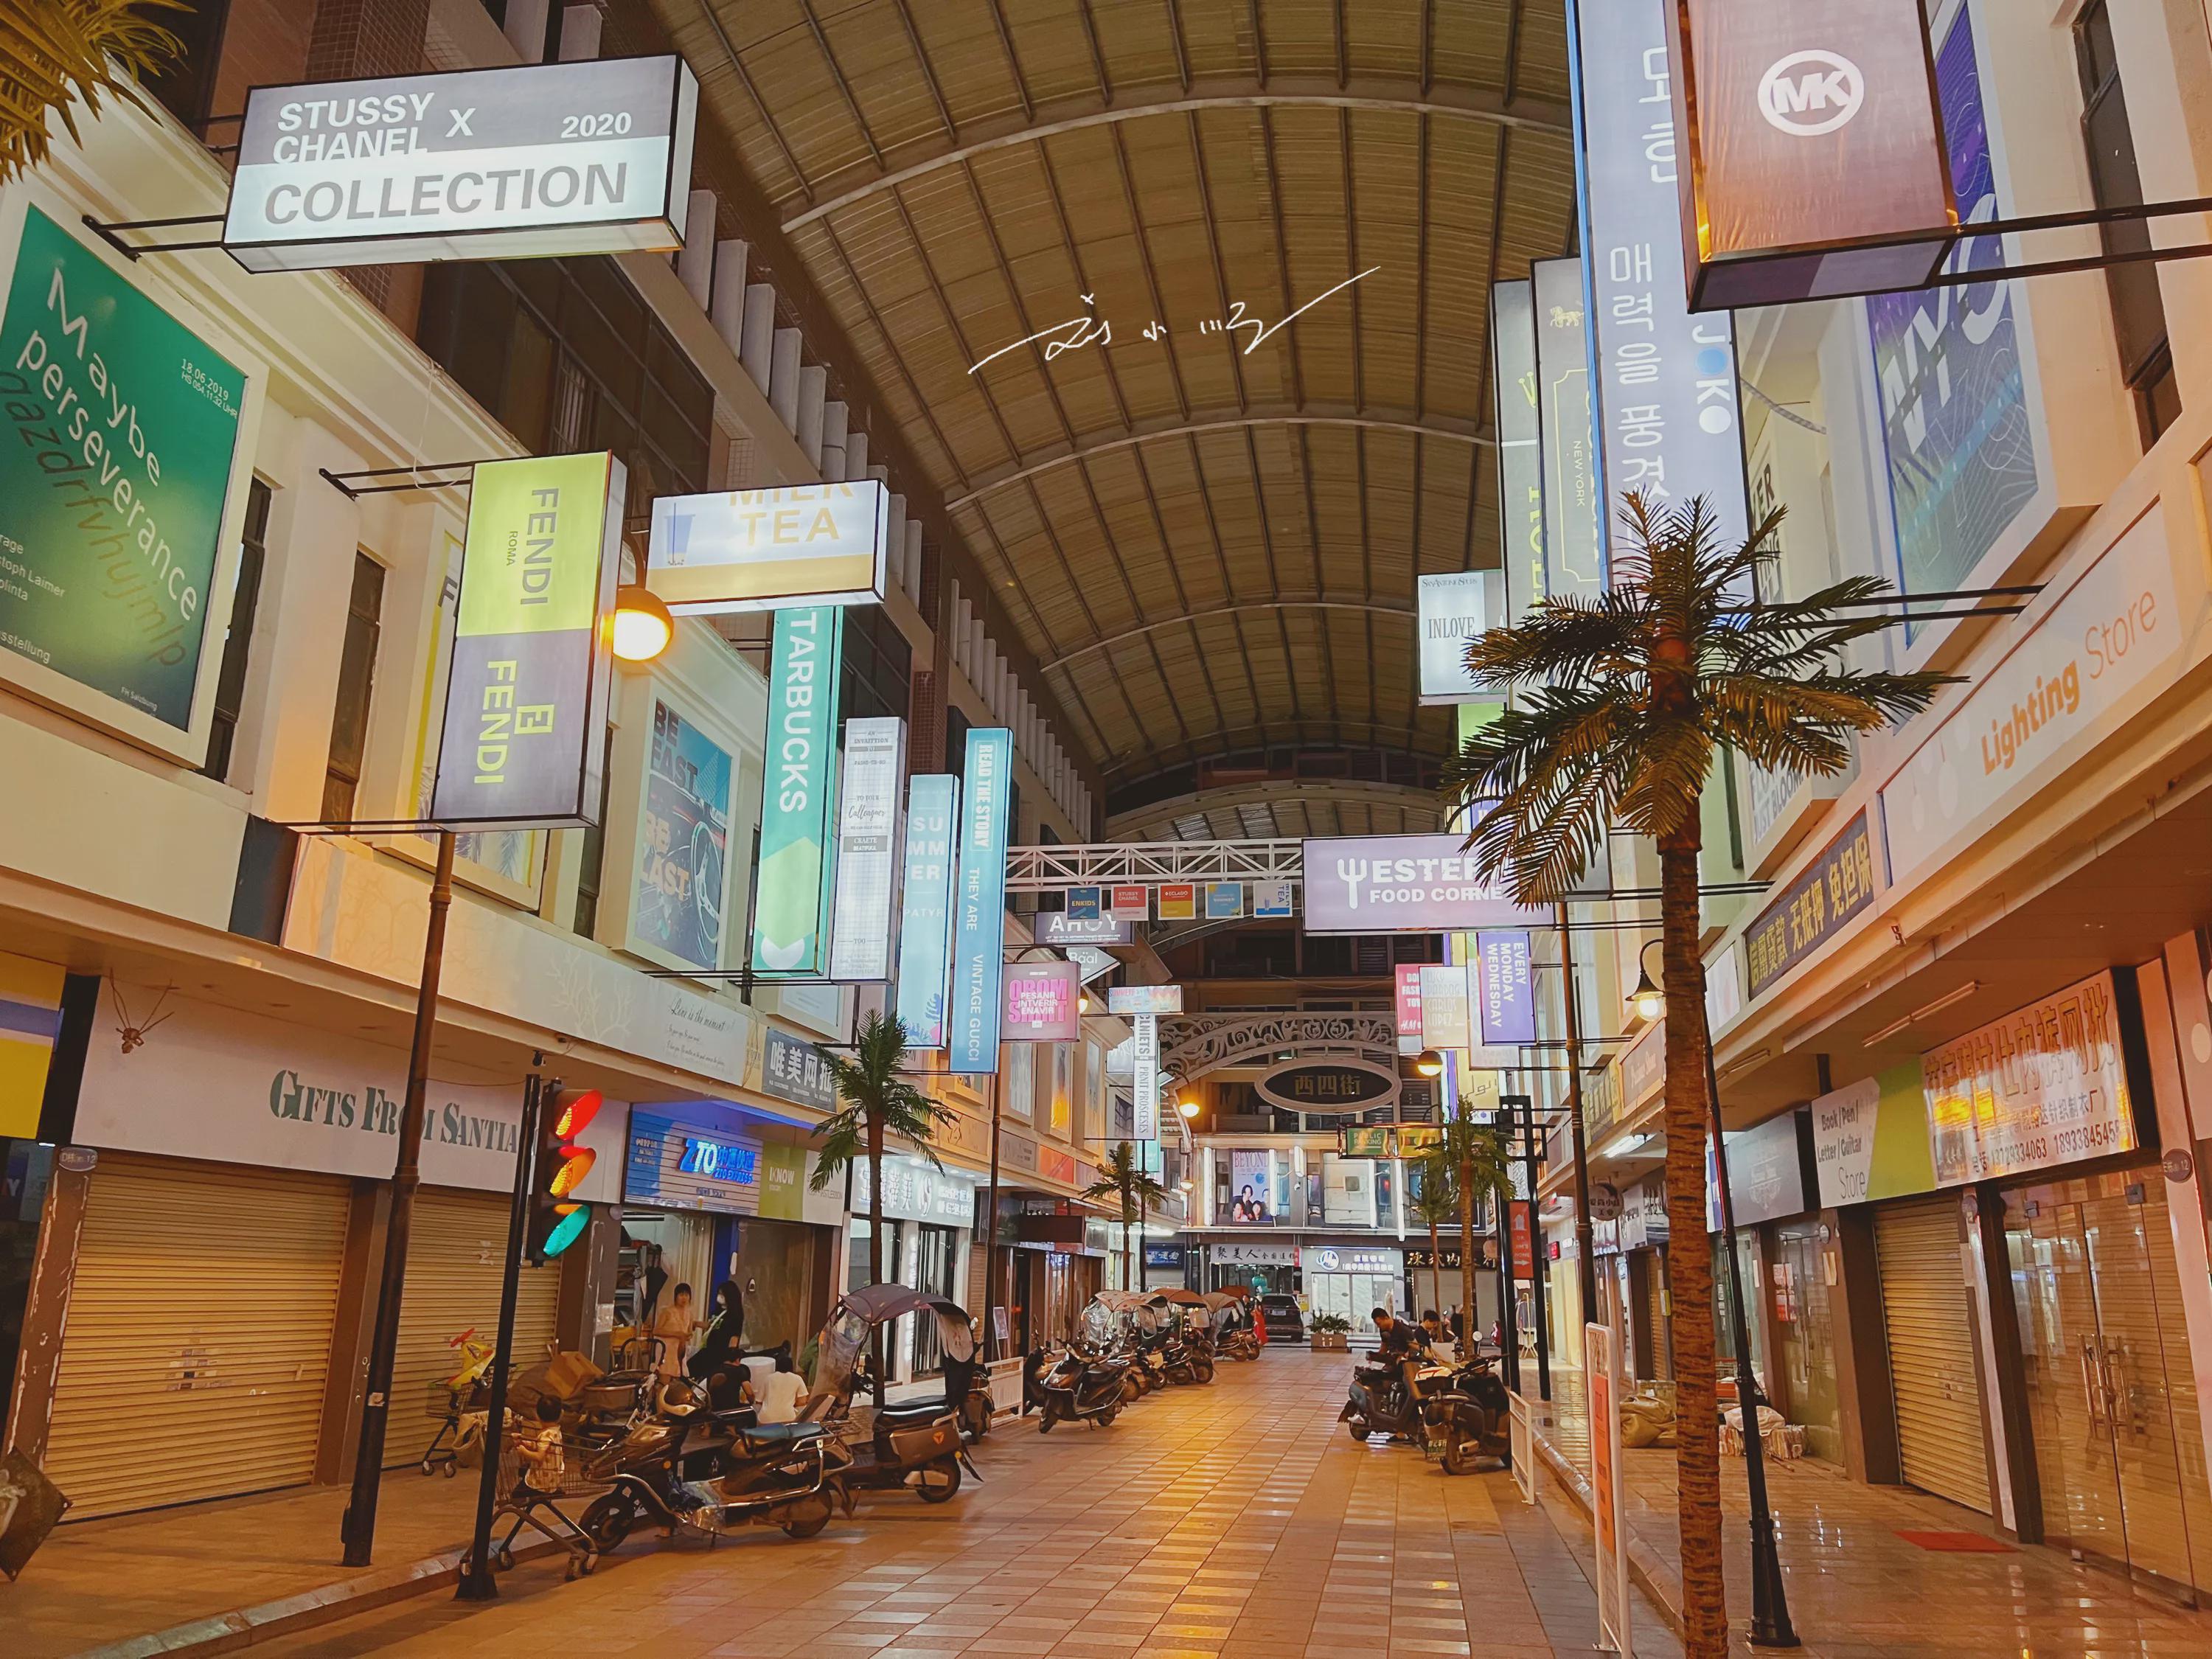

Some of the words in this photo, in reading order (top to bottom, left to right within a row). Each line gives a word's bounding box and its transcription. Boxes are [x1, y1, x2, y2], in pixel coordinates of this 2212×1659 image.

[276, 91, 434, 132] STUSSY
[1773, 70, 1851, 114] MK
[272, 126, 428, 165] CHANEL
[445, 107, 476, 138] X
[561, 112, 633, 139] 2020
[264, 161, 627, 226] COLLECTION
[46, 267, 161, 487] Maybe
[181, 358, 229, 401] 18.06.2019
[15, 329, 198, 621] perseverance
[1573, 440, 1583, 470] NEW
[1576, 471, 1586, 507] YORK
[520, 487, 560, 605] FENDI
[739, 507, 841, 546] TEA
[505, 530, 519, 567] ROMA
[1980, 659, 2081, 776] Lighting
[2084, 591, 2157, 680] Store
[473, 659, 518, 784] FENDI
[779, 611, 817, 813] TARBUCKS
[978, 744, 994, 777] READ
[976, 779, 992, 804] THE
[912, 816, 945, 832] SU
[973, 804, 992, 848] STORY
[906, 840, 946, 857] MM
[911, 864, 941, 881] ER
[967, 867, 981, 902] THEY
[1277, 886, 1285, 903] TEA
[1369, 888, 1425, 904] FOOD
[965, 905, 978, 932] ARE
[970, 953, 984, 1015] VINTAGE
[1500, 942, 1514, 1003] MONDAY
[1512, 942, 1527, 985] EVERY
[1486, 943, 1503, 1028] WEDNESDAY
[967, 1018, 981, 1061] GUCCI
[269, 1069, 356, 1128] GIFTS
[679, 1138, 718, 1175] ZTO
[1837, 1166, 1865, 1199] Store
